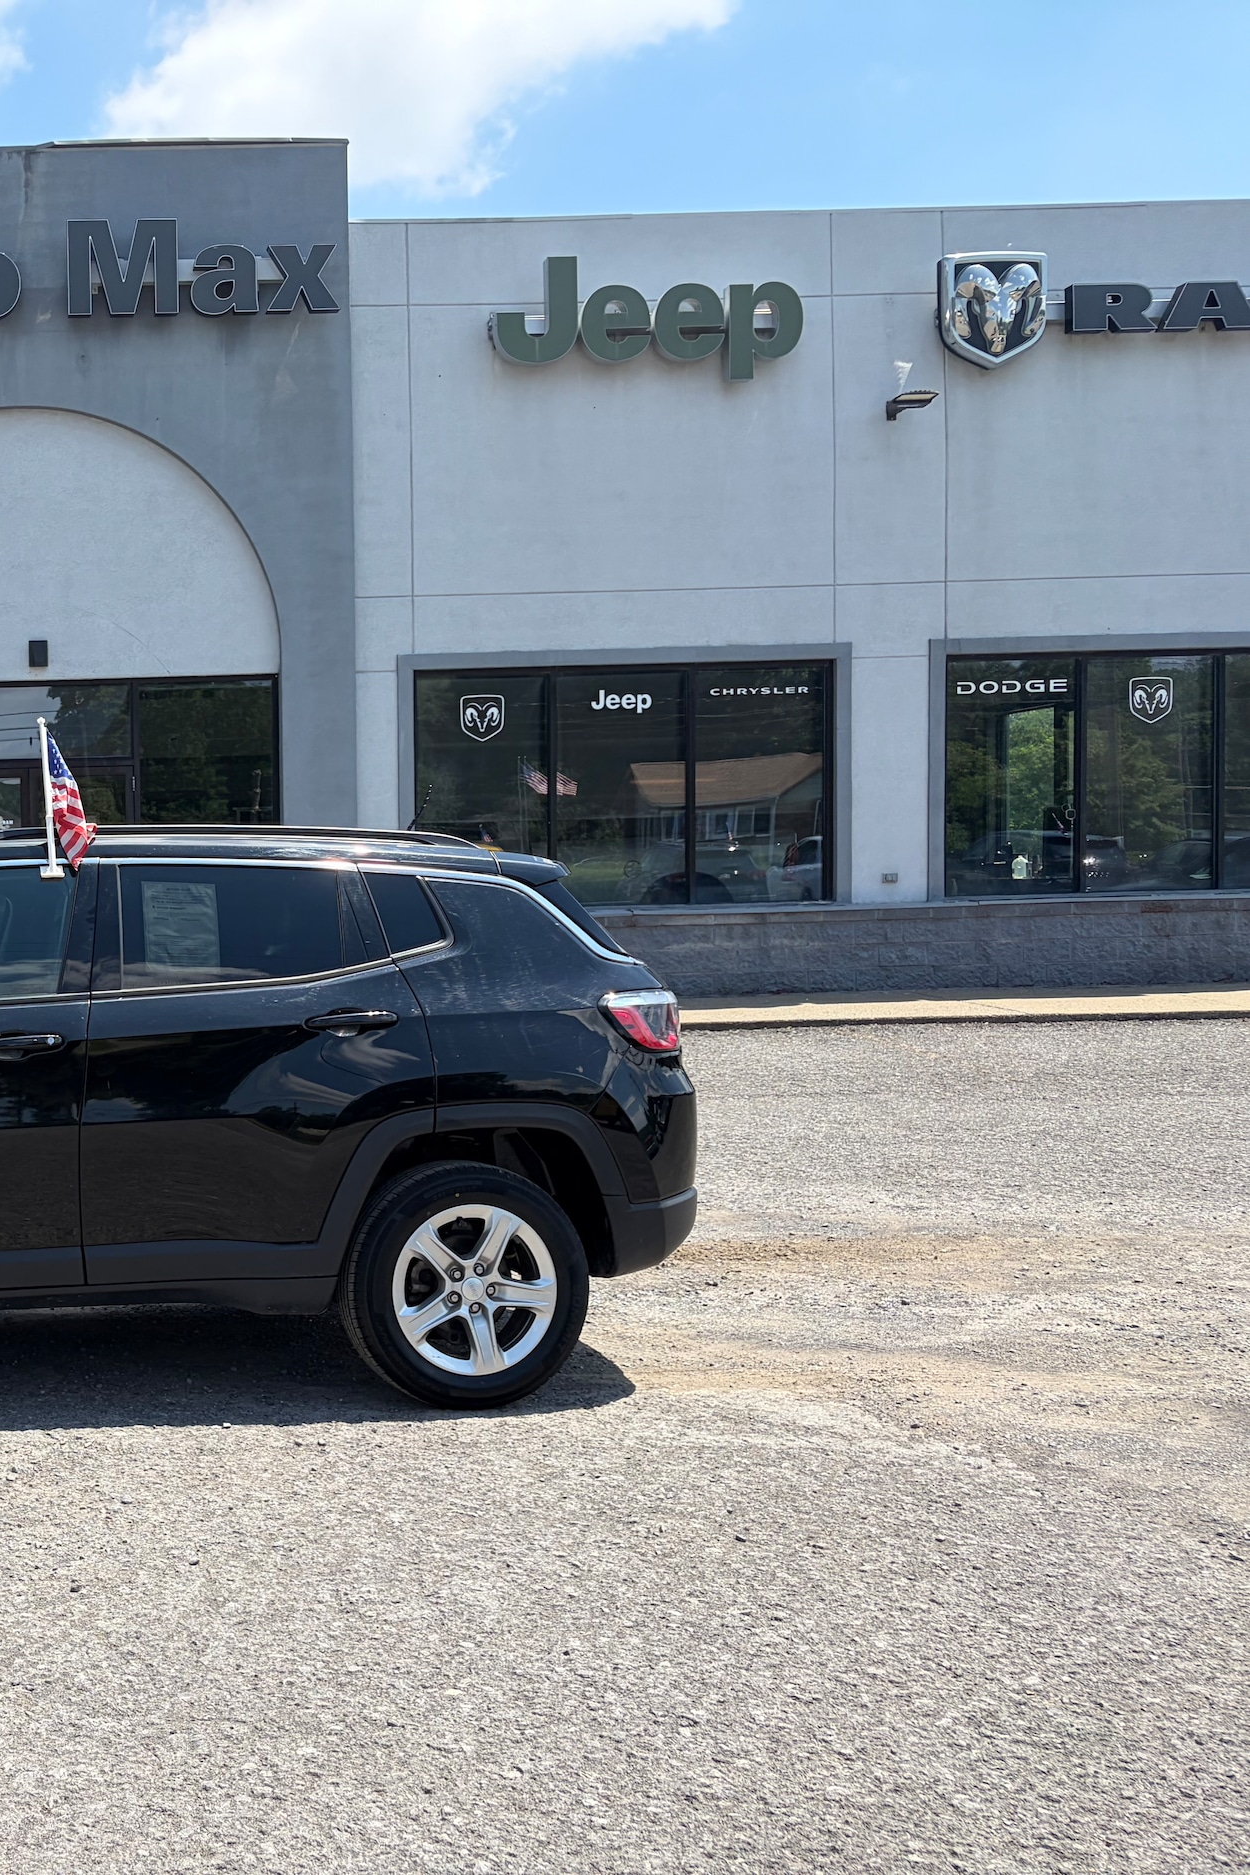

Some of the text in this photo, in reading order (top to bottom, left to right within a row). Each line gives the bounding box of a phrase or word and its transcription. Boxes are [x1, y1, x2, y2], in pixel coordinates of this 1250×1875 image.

[66, 218, 341, 317] Max
[493, 256, 803, 381] Jeep
[709, 685, 810, 696] CHRYSLER
[956, 678, 1068, 695] DODGE
[591, 689, 652, 713] Jeep
